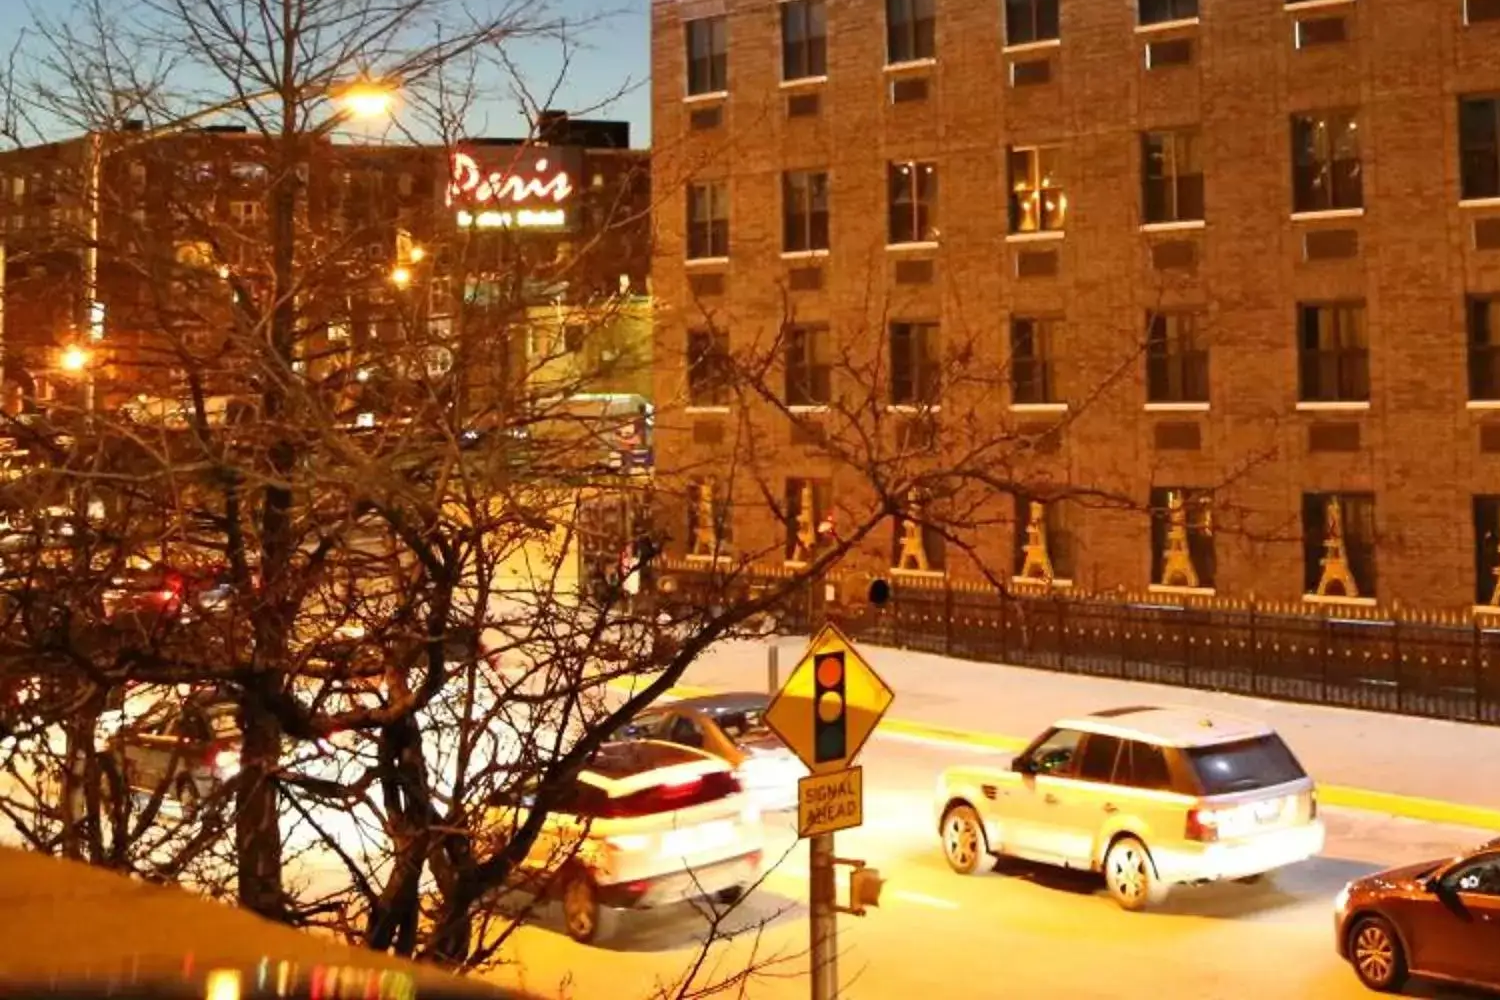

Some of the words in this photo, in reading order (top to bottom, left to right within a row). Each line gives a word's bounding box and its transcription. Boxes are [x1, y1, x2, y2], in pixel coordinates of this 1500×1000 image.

[445, 152, 573, 207] Paris
[805, 781, 855, 804] SIGNAL
[807, 801, 857, 825] AHEAD
